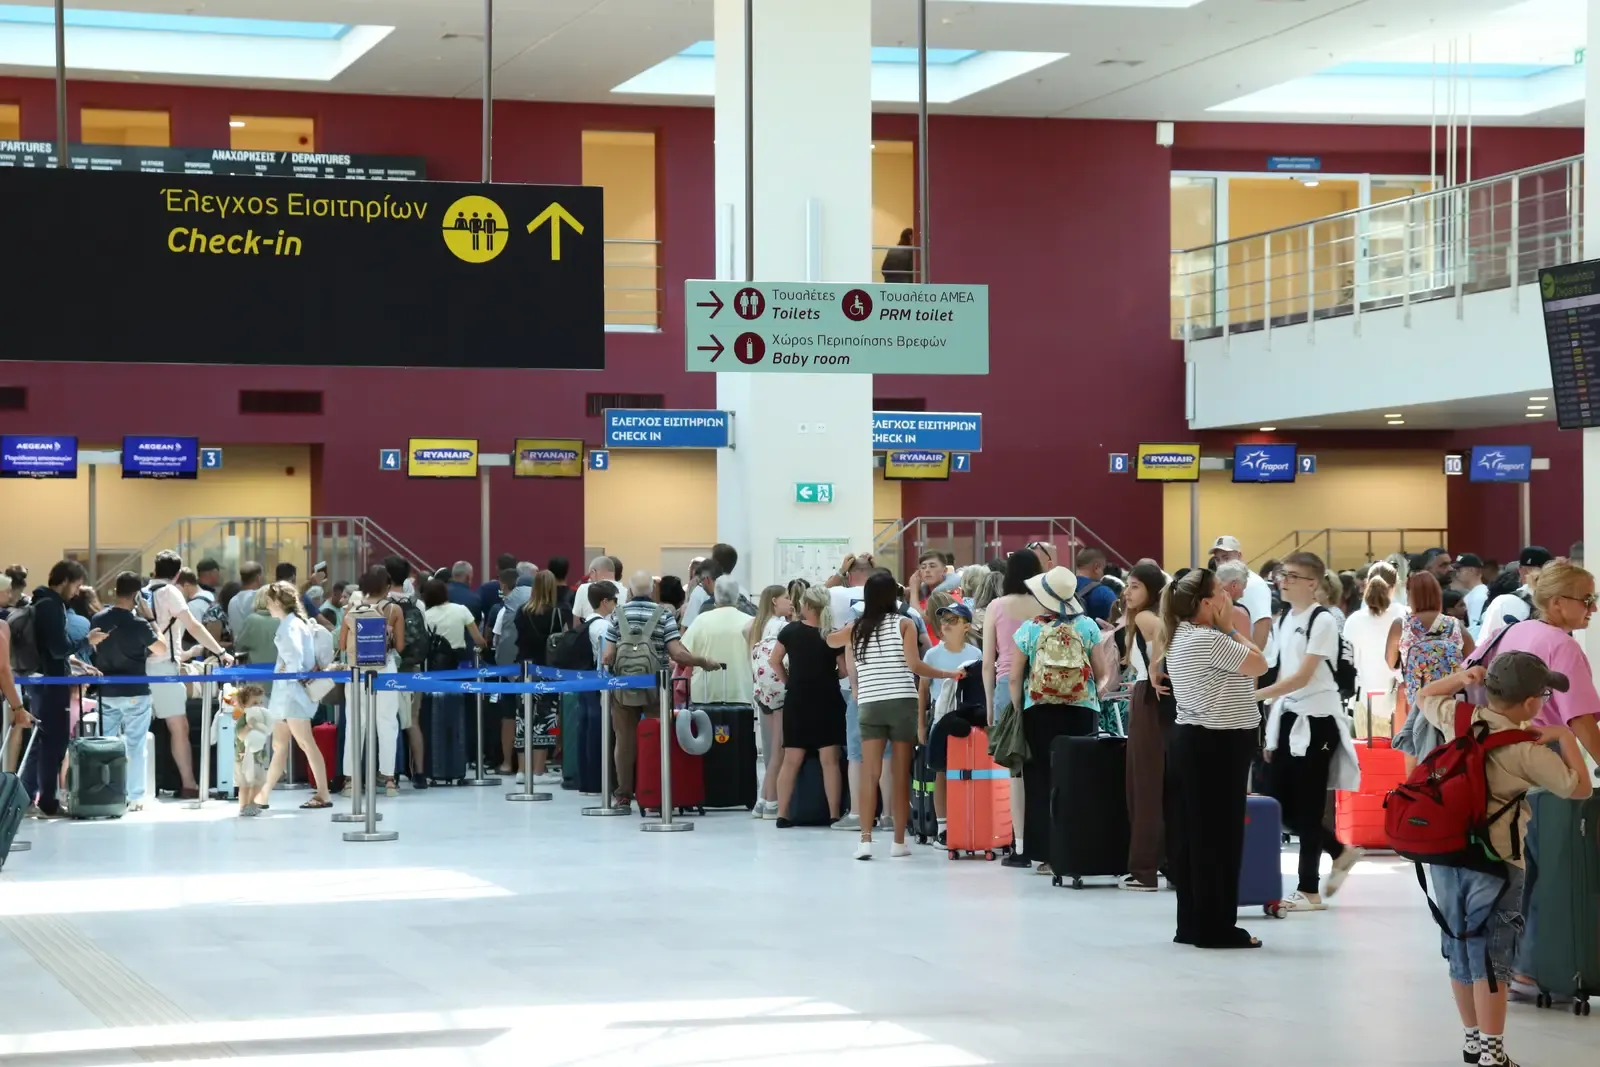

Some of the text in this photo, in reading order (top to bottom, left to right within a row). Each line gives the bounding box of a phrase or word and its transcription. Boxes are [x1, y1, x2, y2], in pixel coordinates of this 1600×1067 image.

[0, 140, 53, 154] PARTURES
[211, 150, 351, 165] ΑΝΑΧΩΡΗΣΕΙΣ / DEPARTURES
[160, 188, 428, 223] Έλεγχος Εισιτηρίων
[167, 227, 302, 256] Check-in
[772, 289, 836, 302] Τουαλέτες
[880, 290, 975, 303] Τουαλέτα ΑΜΕΑ
[772, 307, 820, 321] Toilets
[879, 308, 954, 322] PRM toilet
[772, 333, 947, 349] Χώρος Περιποίησης Βρεφών
[772, 352, 850, 366] Baby room
[611, 417, 724, 427] ΕΛΕΓΧΟΣ ΕΙΣΙΤΗΡΙΩΝ
[918, 420, 976, 431] ΕΙΣΙΤΗΡΙΩΝ
[611, 431, 662, 441] CHECK IN
[905, 434, 917, 443] IN
[206, 452, 216, 466] 3
[385, 453, 395, 467] 4
[423, 451, 470, 459] RYANAIR
[529, 451, 576, 459] RYANAIR
[595, 454, 604, 468] 5
[899, 453, 943, 461] RYANAIR
[1150, 455, 1193, 463] RYANAIR
[957, 456, 965, 469] 7
[1115, 457, 1123, 470] 8
[1261, 462, 1289, 472] Fraport
[1302, 457, 1311, 472] 9
[1447, 459, 1460, 472] 10
